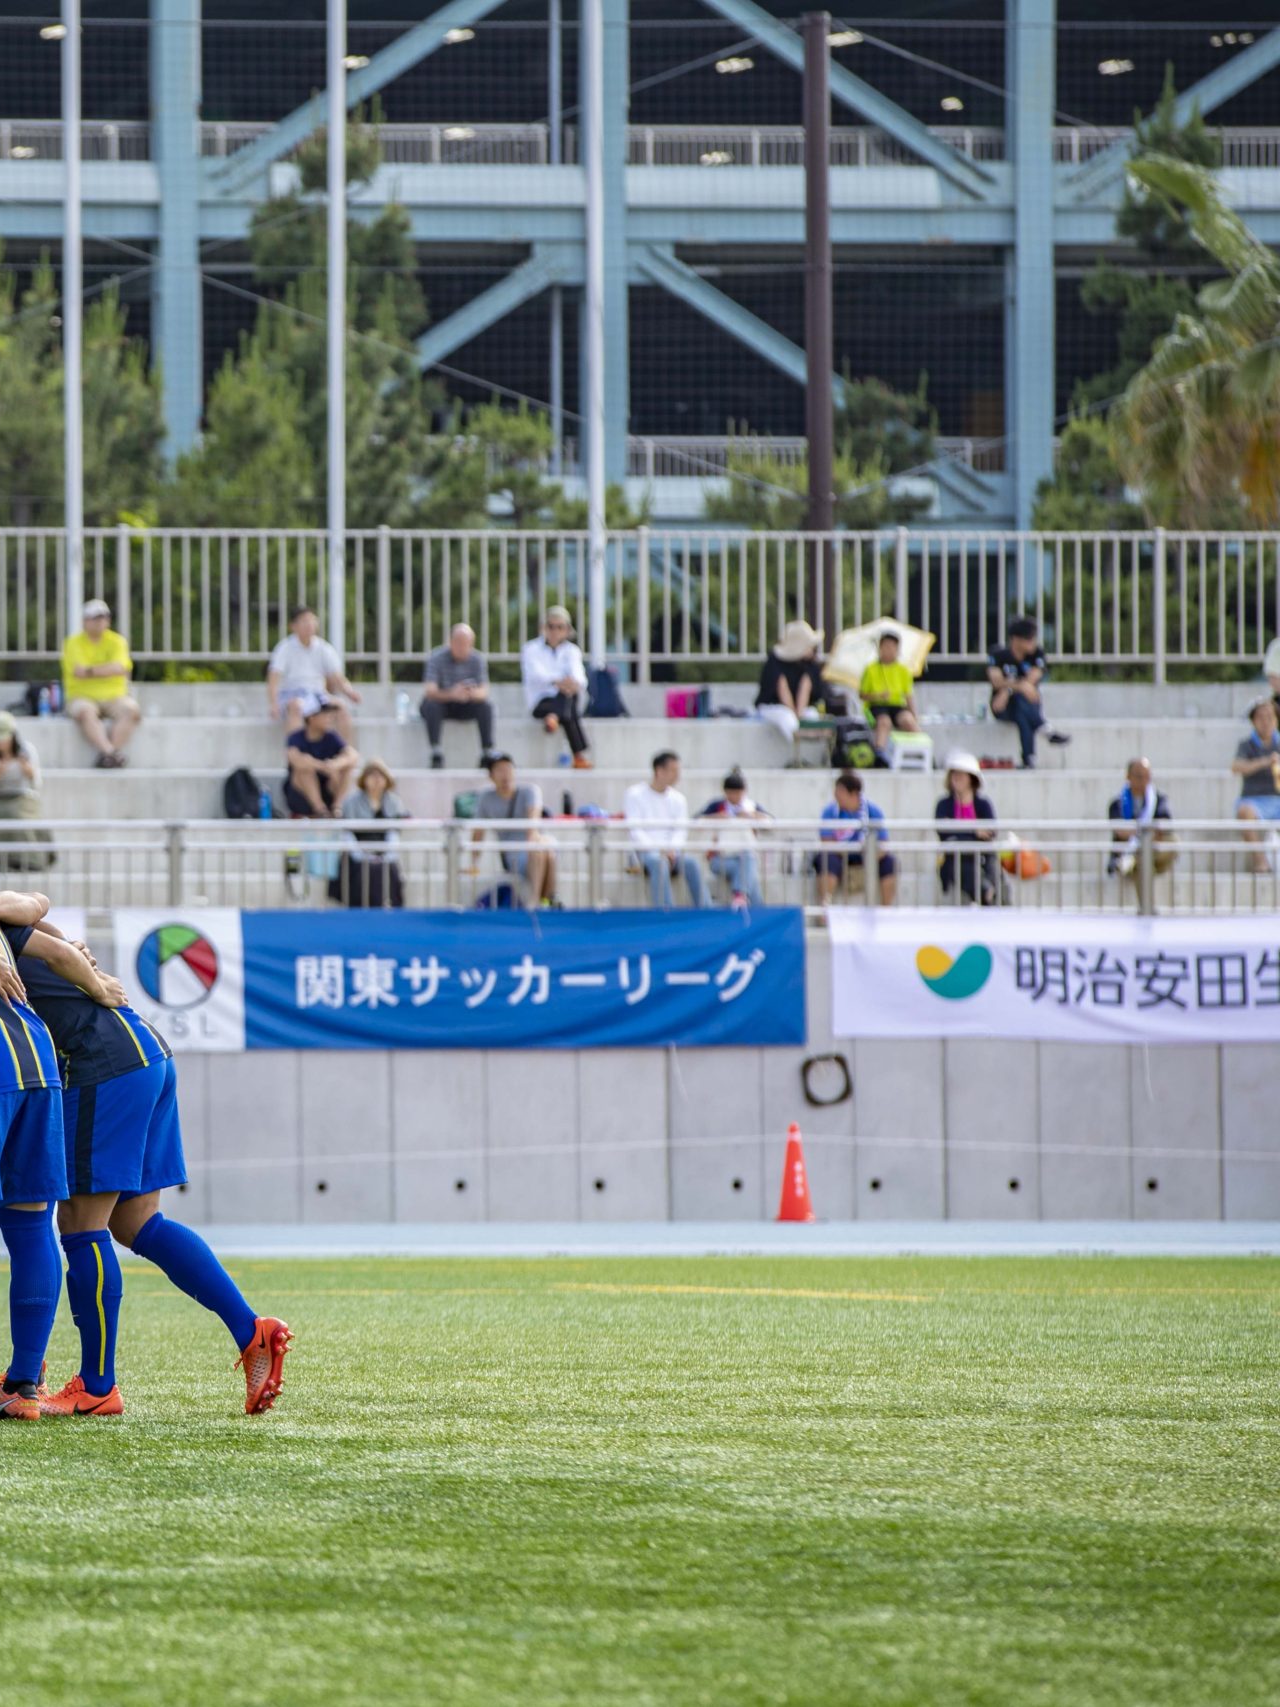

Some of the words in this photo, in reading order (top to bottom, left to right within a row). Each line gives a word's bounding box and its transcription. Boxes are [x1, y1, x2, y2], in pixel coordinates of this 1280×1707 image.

[294, 947, 766, 1010] 関東サッカーリーグ
